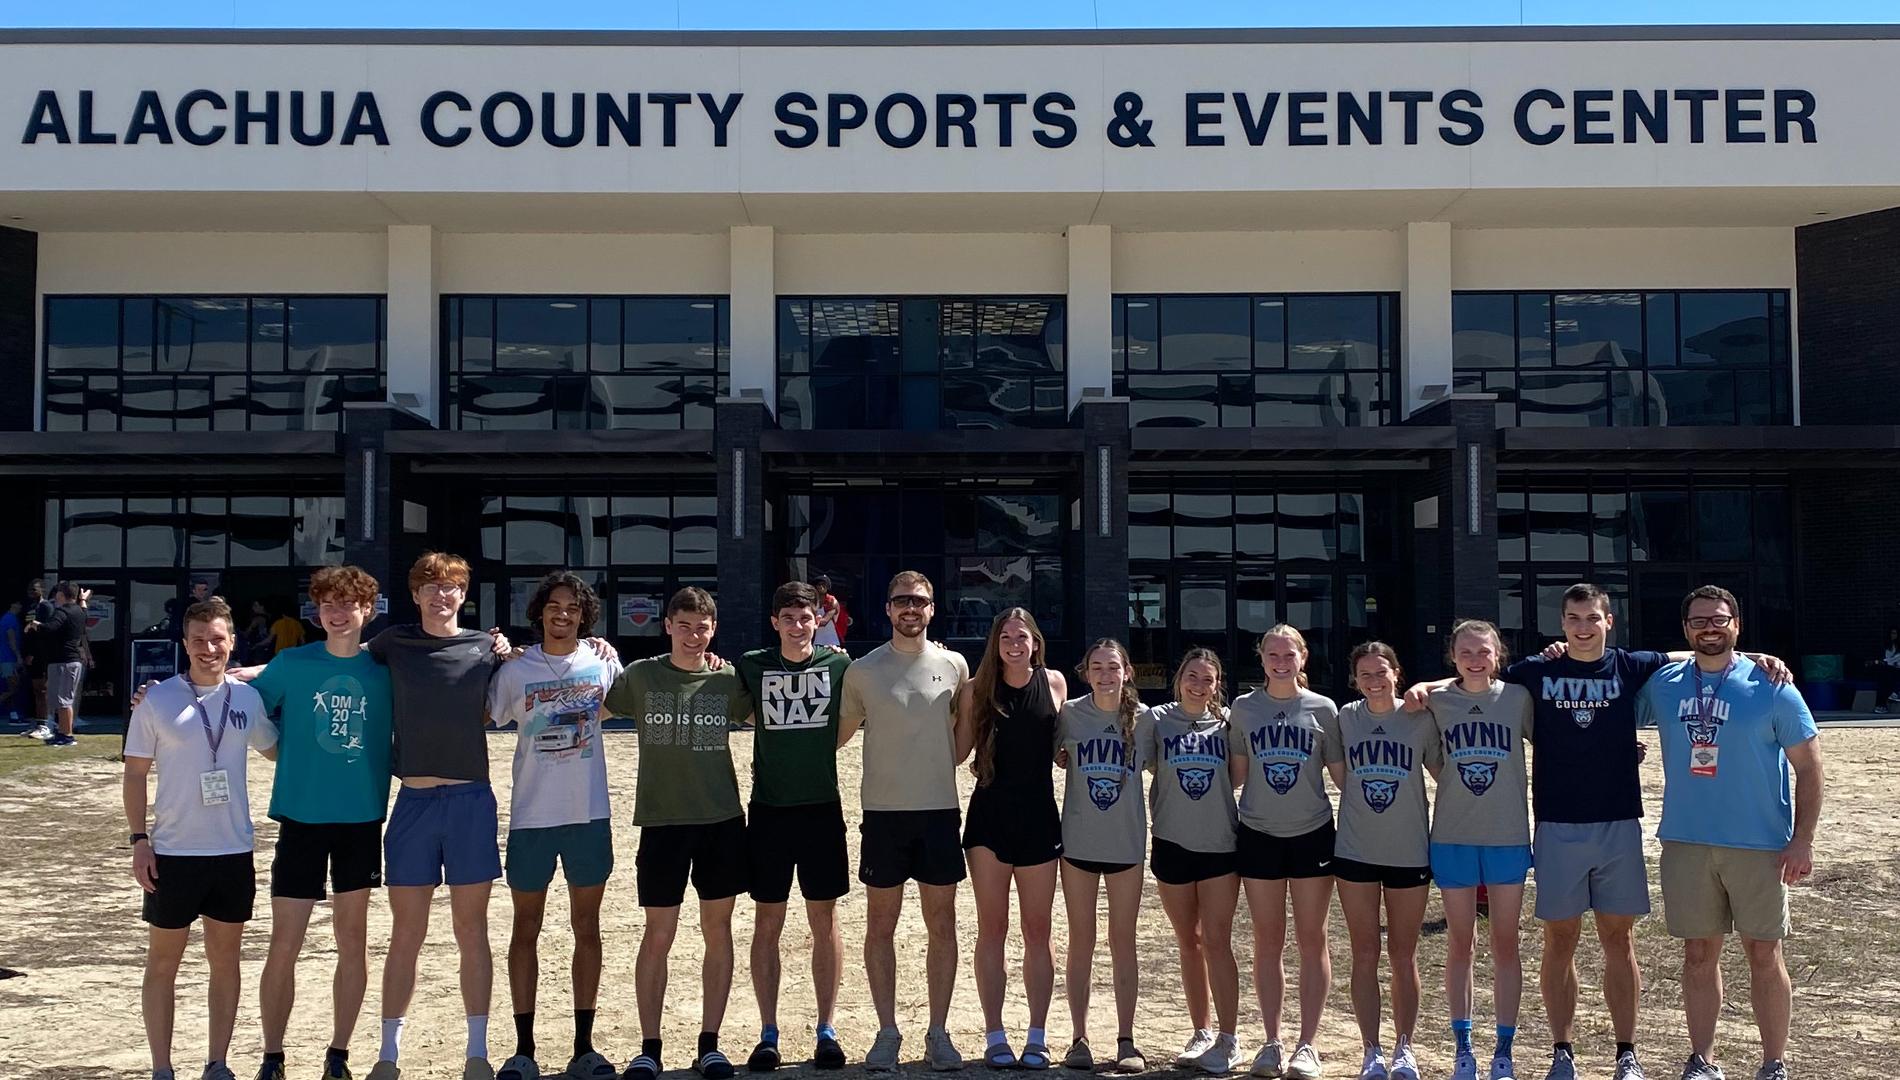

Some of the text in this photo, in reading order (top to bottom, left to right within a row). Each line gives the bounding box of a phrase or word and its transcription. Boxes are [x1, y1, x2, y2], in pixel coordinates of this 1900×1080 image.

[21, 88, 1818, 149] ALACHUA COUNTY SPORTS & EVENTS CENTER
[761, 671, 831, 701] RUN
[1542, 675, 1621, 701] MVNU
[330, 695, 352, 709] DM
[761, 697, 831, 725] NAZ
[1555, 700, 1610, 709] COUGARS
[331, 708, 349, 722] 20
[644, 713, 727, 726] GOD IS GOOD
[330, 722, 348, 737] 24
[1444, 721, 1511, 754] MVNU
[1163, 734, 1225, 761] MVNU
[1250, 724, 1314, 756] MVNU
[1349, 739, 1413, 772] MVNU
[1451, 749, 1505, 759] CROSS COUNTRY
[1103, 766, 1131, 777] COUNTY
[1376, 767, 1406, 777] COUNTRY
